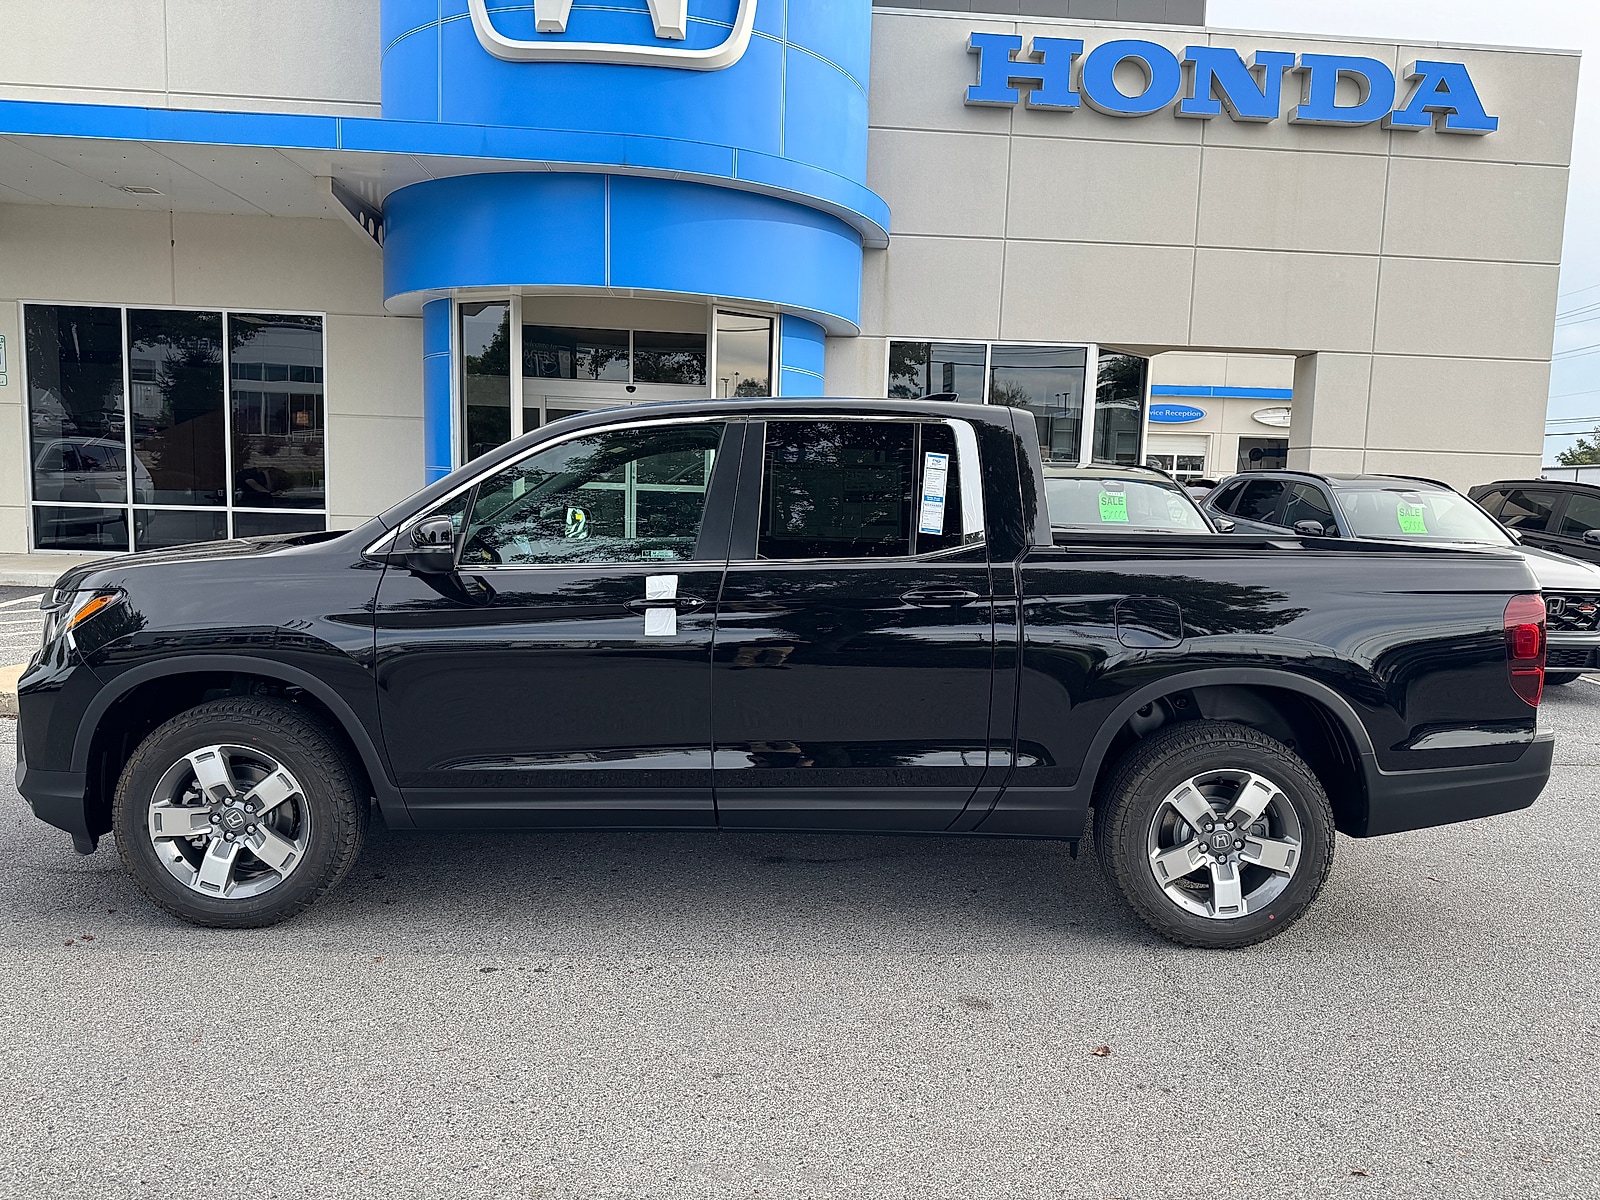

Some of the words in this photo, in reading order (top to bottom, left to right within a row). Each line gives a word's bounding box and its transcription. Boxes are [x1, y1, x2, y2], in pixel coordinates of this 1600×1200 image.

[965, 32, 1499, 135] HONDA
[1165, 409, 1201, 417] Reception
[1101, 497, 1124, 506] SALE
[1399, 508, 1420, 517] SALE
